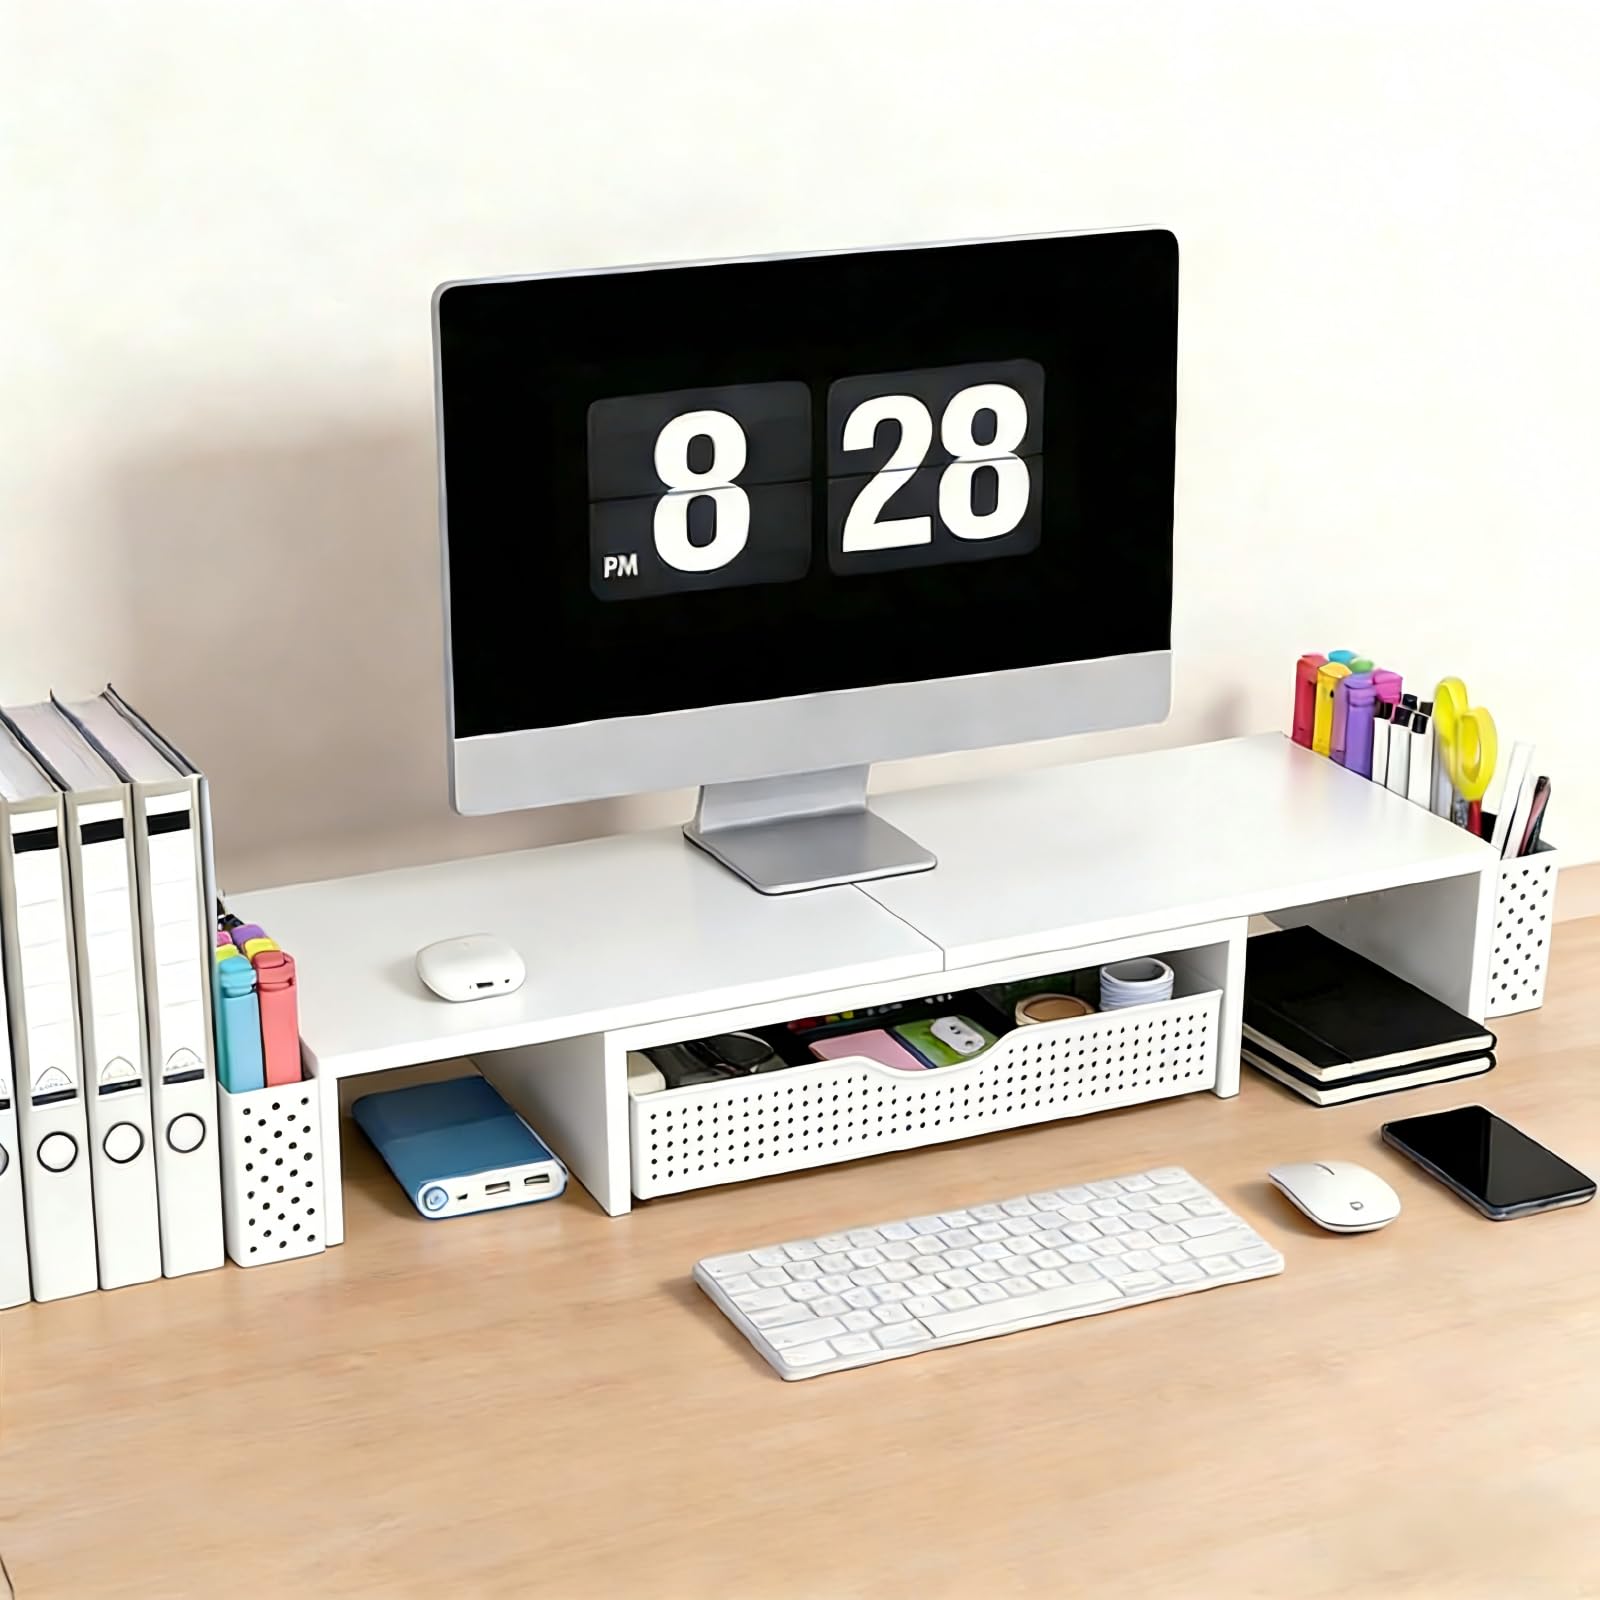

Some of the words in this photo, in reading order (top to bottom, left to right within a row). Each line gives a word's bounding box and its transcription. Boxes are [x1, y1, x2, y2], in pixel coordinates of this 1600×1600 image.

[653, 410, 751, 572] 8
[842, 383, 1030, 553] 28
[603, 553, 638, 578] PM
